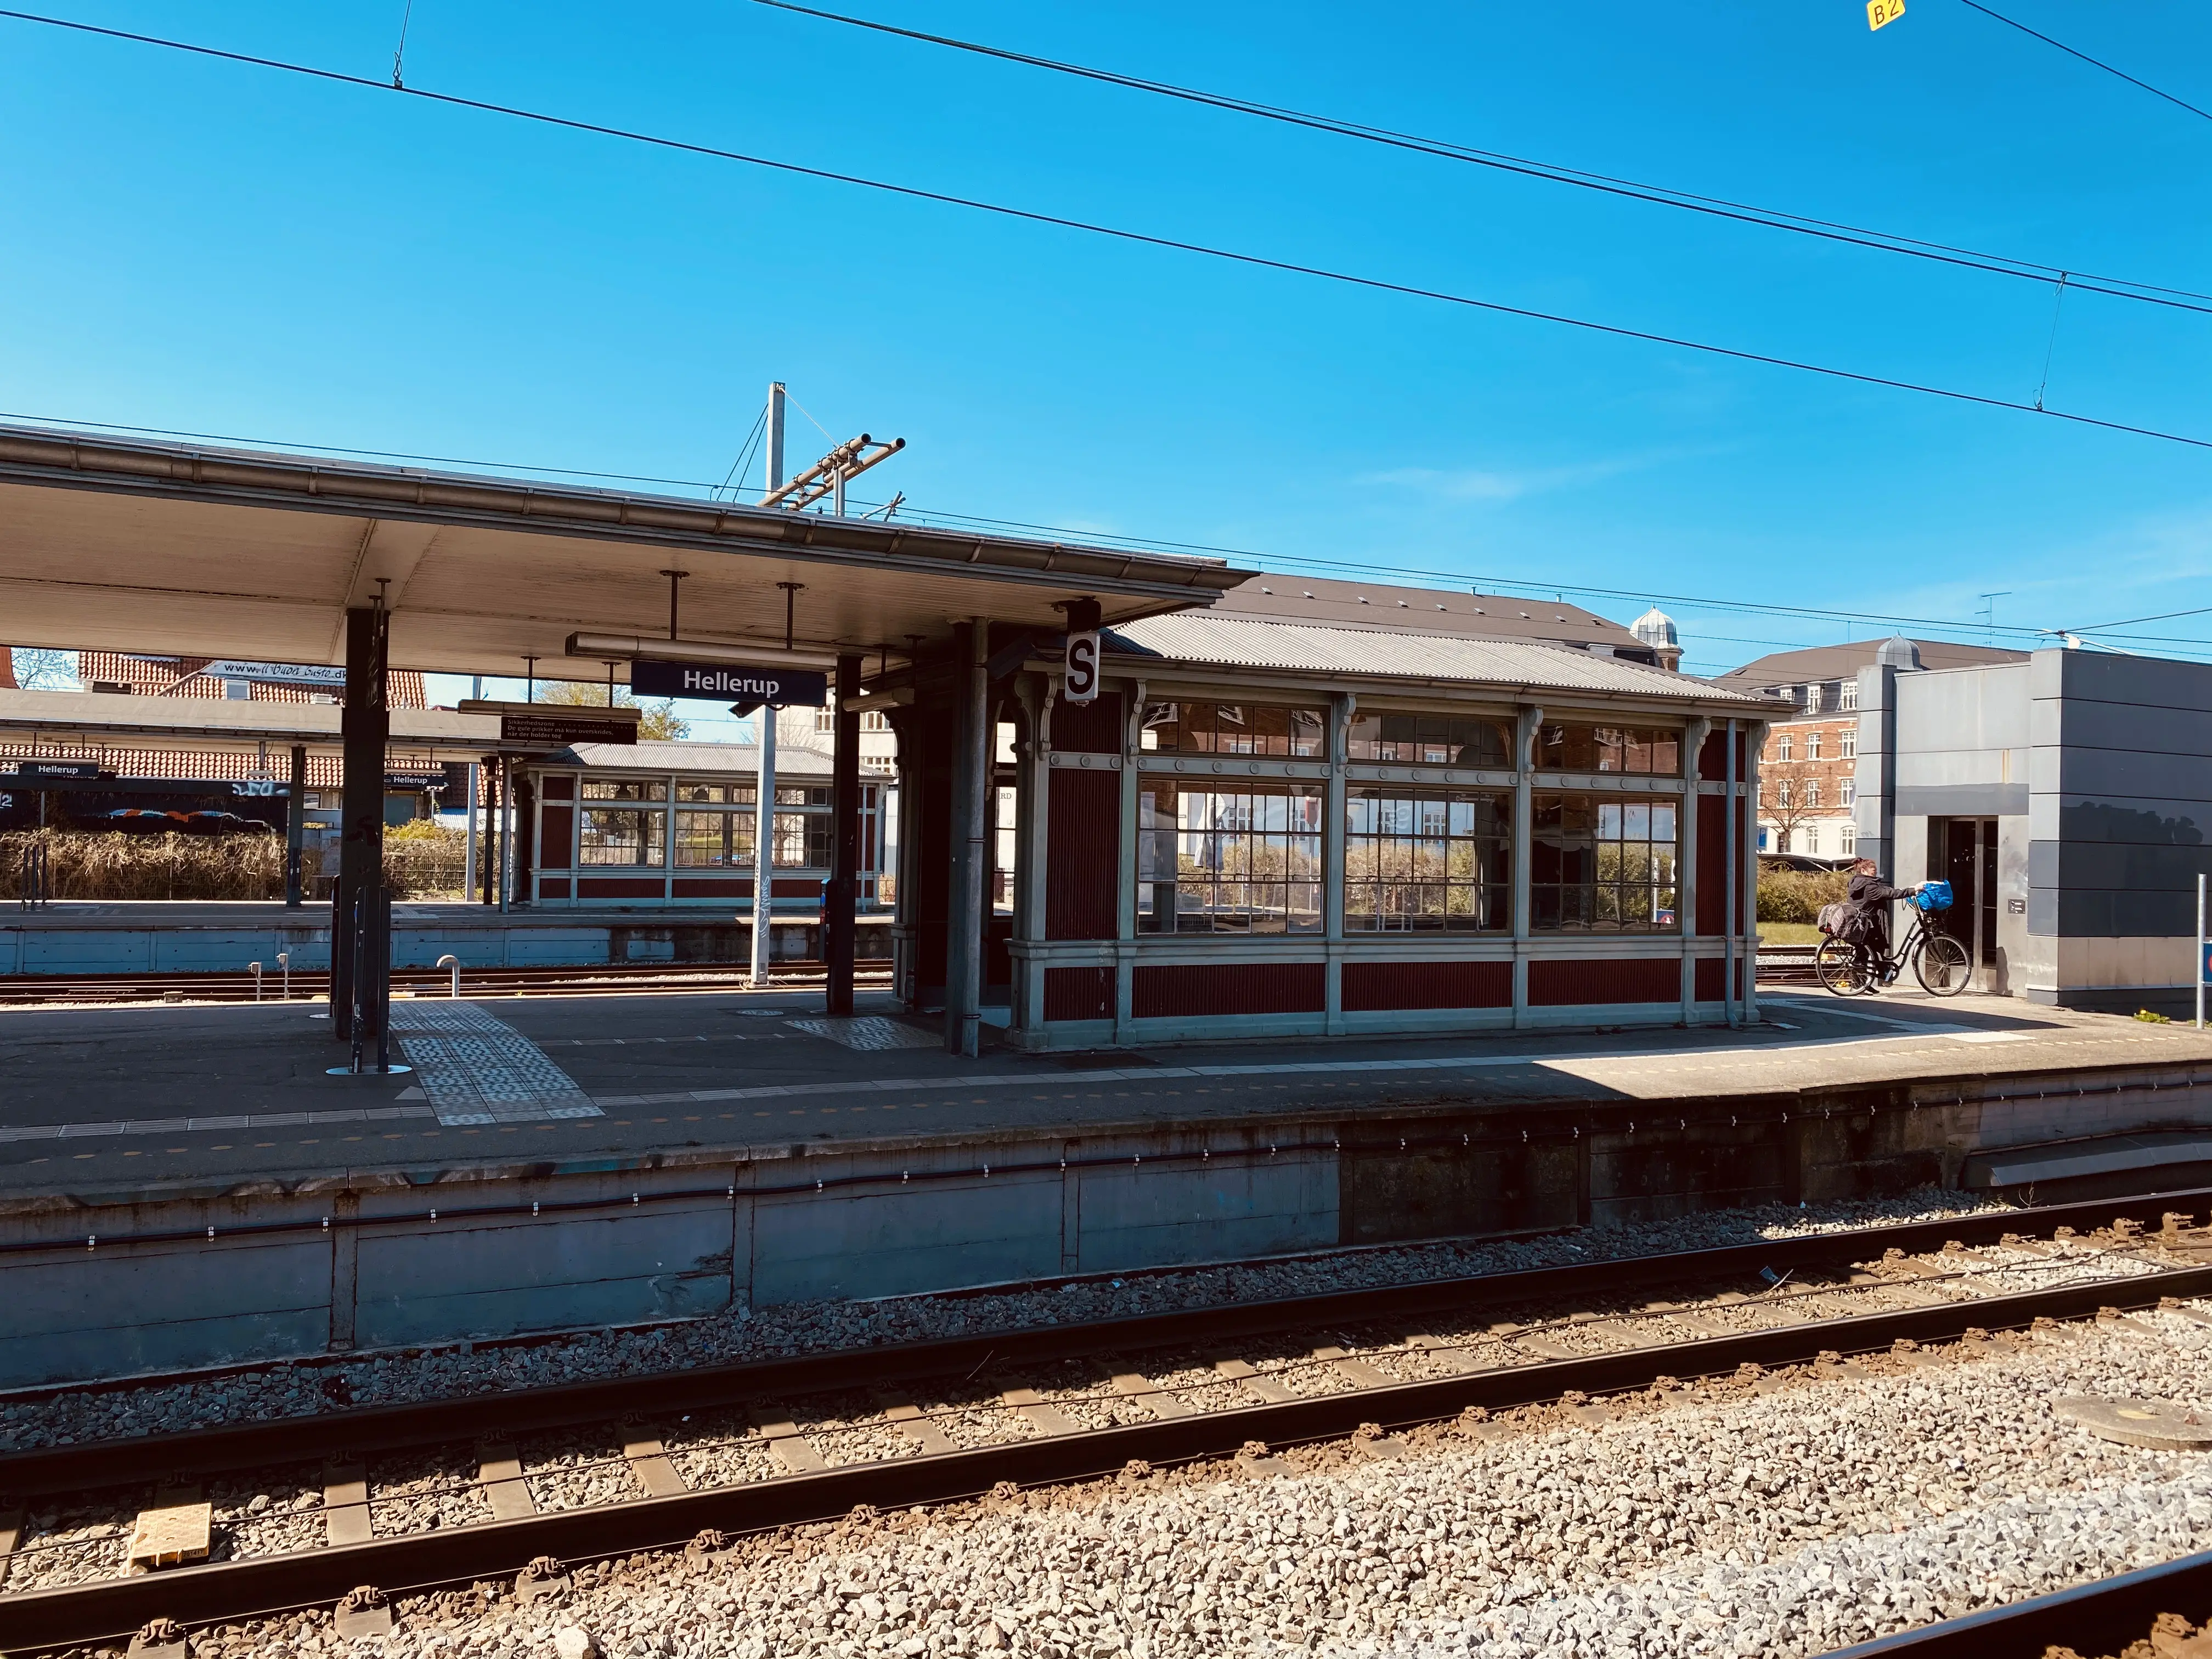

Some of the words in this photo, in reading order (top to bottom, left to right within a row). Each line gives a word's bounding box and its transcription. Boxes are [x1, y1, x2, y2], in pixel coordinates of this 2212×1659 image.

[1067, 639, 1094, 695] S
[684, 670, 779, 698] Hellerup
[38, 765, 78, 775] Hellerup
[393, 776, 428, 785] Hellerup
